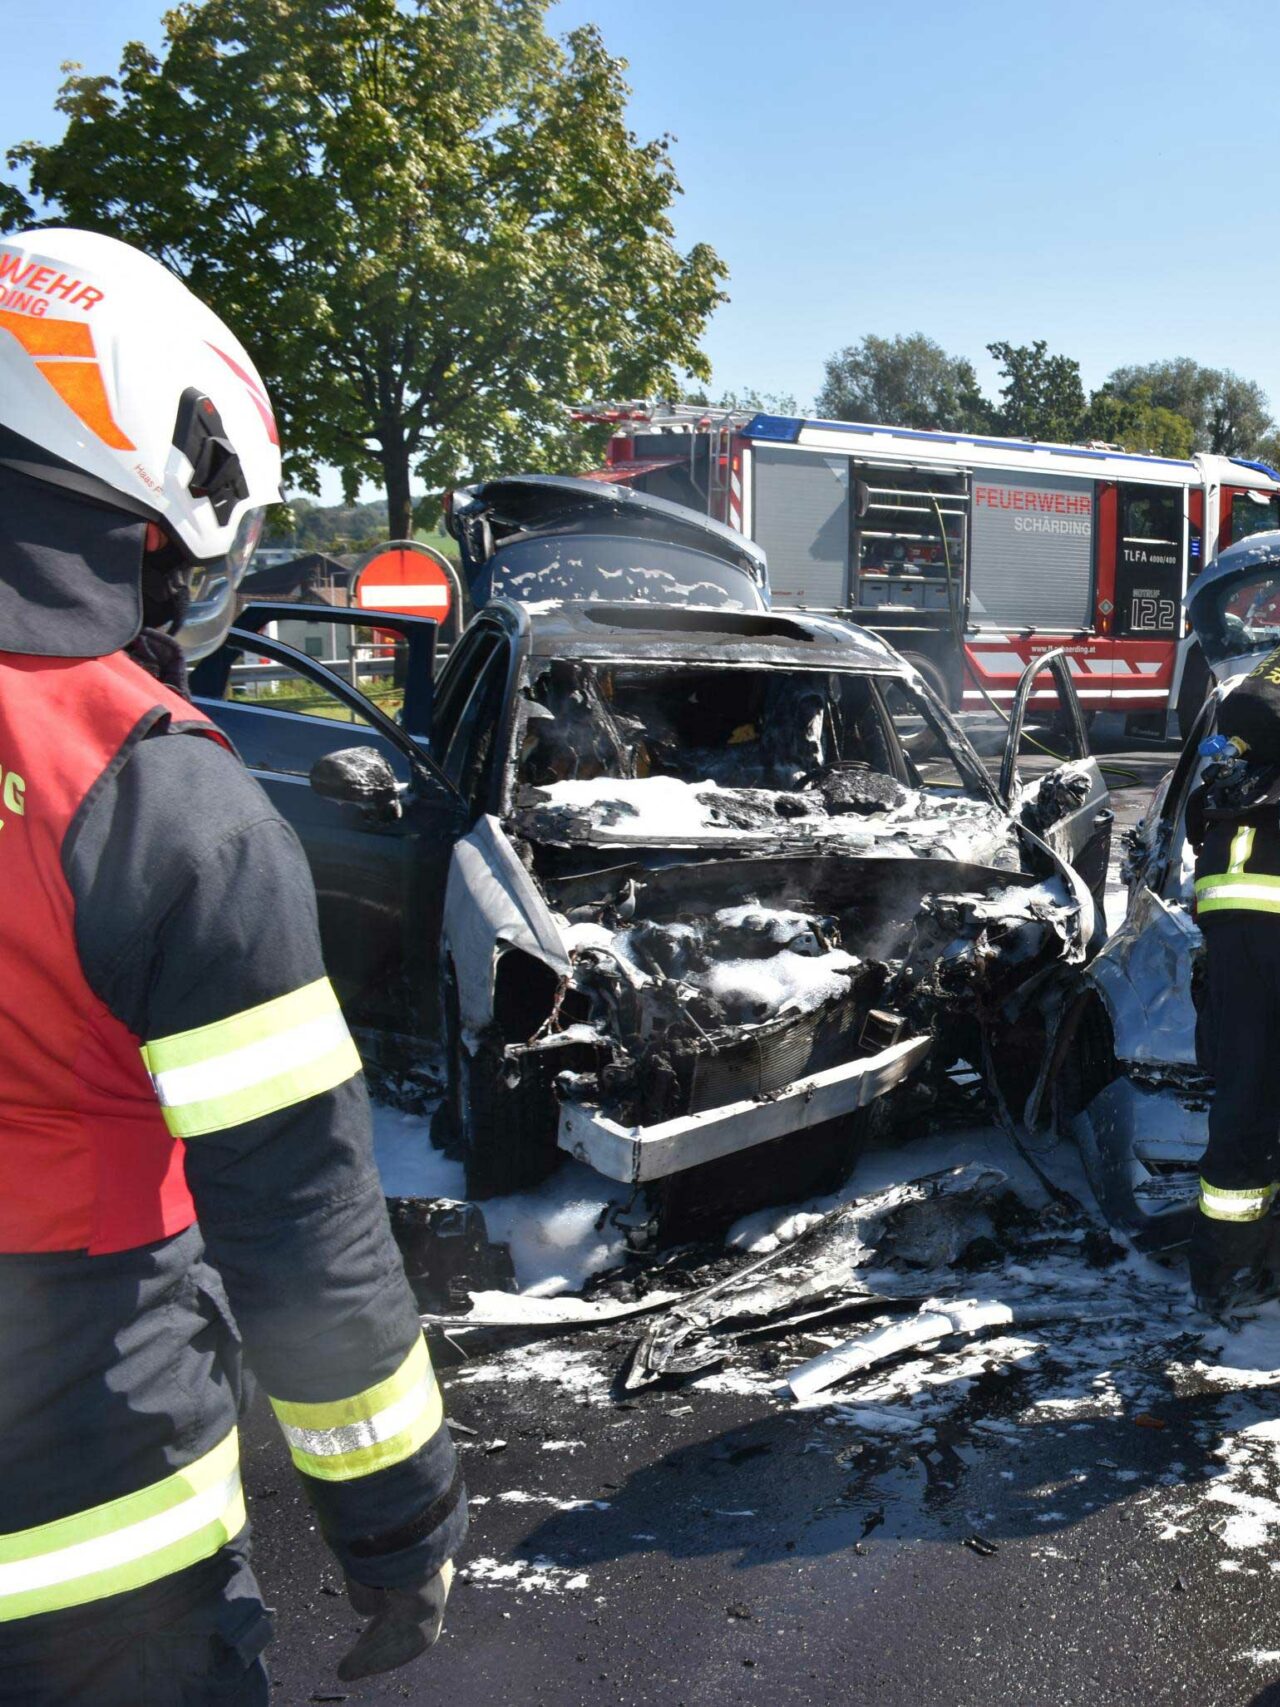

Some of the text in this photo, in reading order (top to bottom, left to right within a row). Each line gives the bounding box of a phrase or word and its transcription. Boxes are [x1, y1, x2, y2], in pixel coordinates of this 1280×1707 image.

[975, 486, 1091, 515] FEUERWEHR
[1014, 515, 1091, 535] SCHÄRDING
[1123, 549, 1148, 563] TLFA
[1131, 598, 1176, 629] 122
